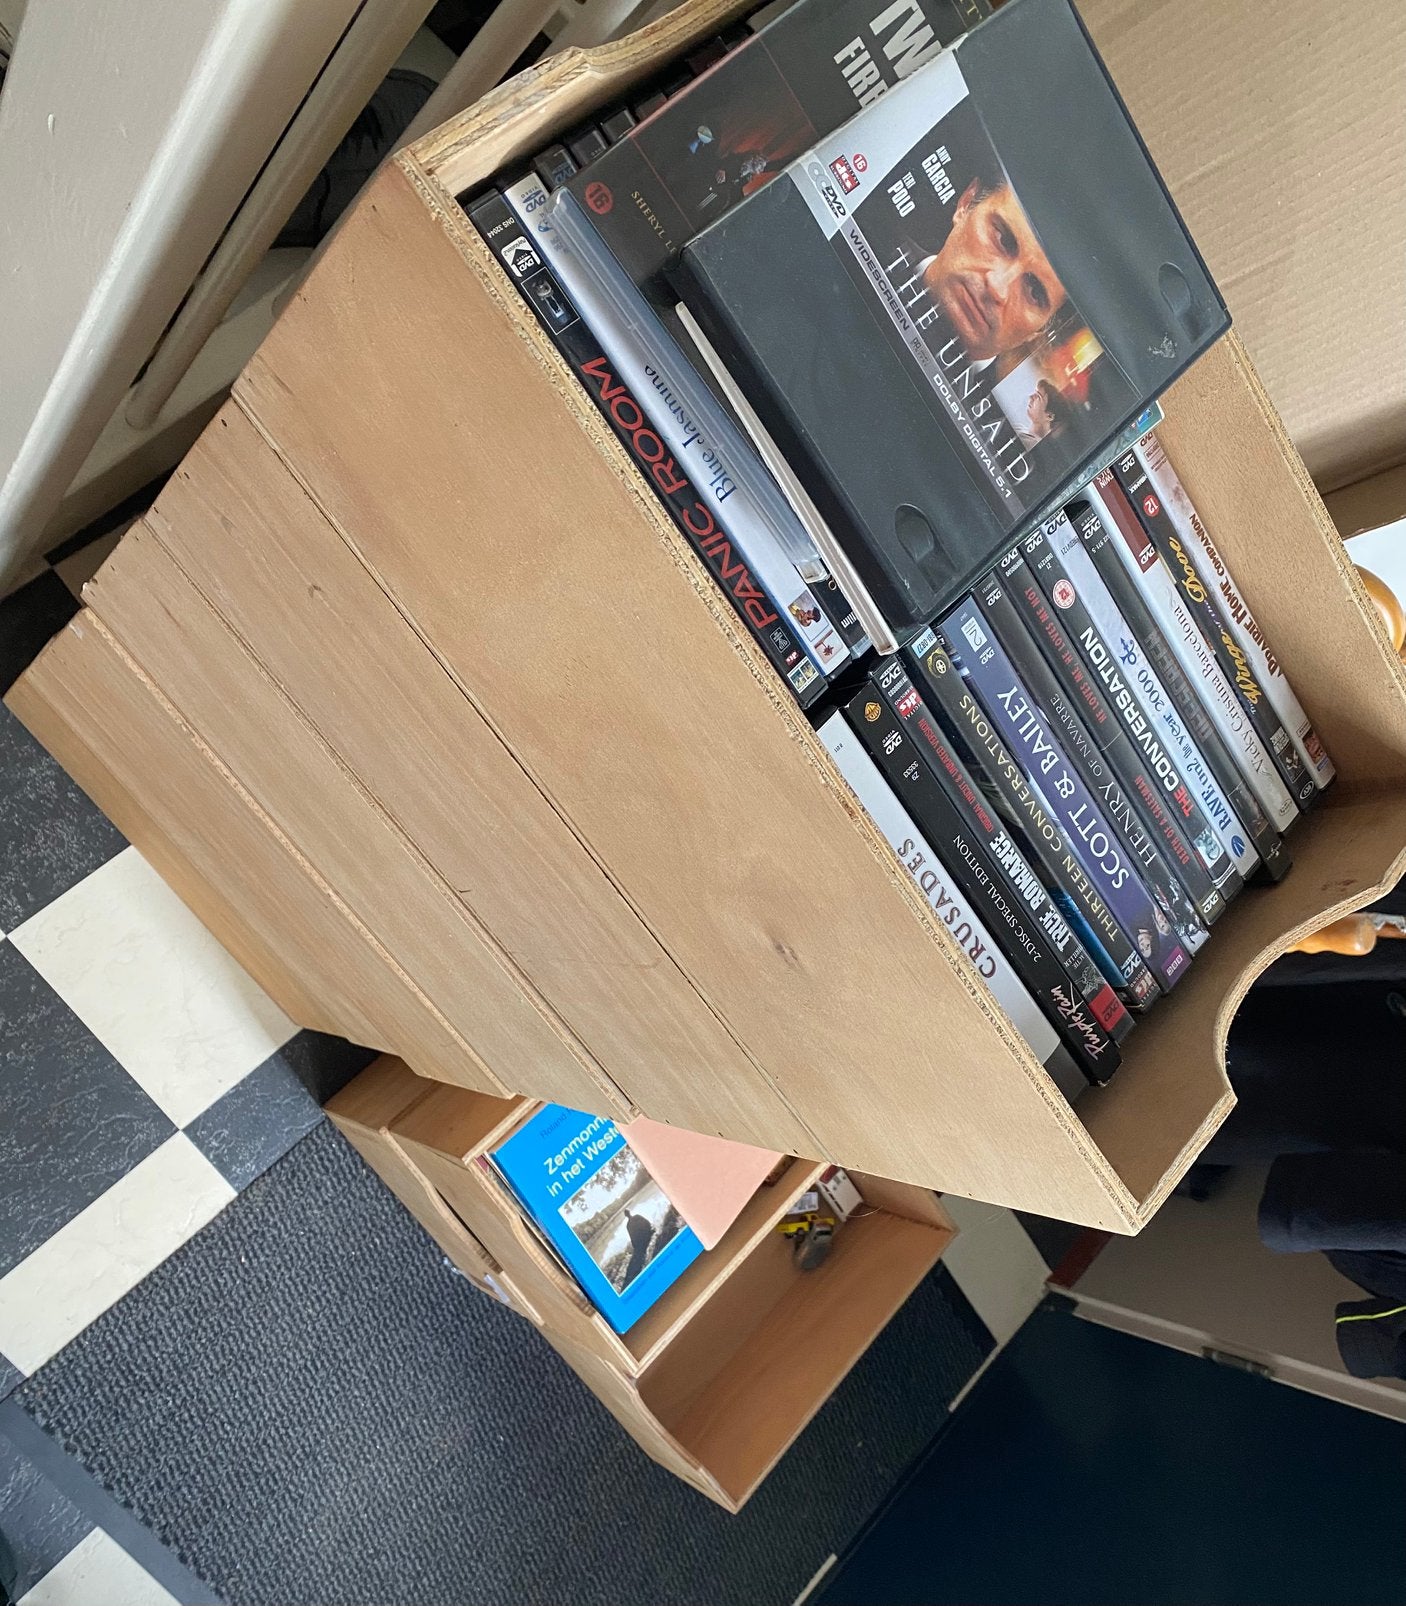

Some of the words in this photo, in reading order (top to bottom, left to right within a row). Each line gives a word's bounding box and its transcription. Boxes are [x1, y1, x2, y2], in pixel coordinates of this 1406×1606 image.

[854, 155, 866, 171] 16
[936, 146, 951, 166] ANDY
[836, 163, 852, 188] dts
[903, 172, 916, 189] TERI
[922, 154, 955, 204] GARCIA
[526, 194, 546, 212] DVD
[632, 190, 665, 238] SHERYL
[825, 186, 846, 216] DVD
[887, 180, 916, 217] POLO
[518, 256, 534, 272] DVD
[850, 228, 910, 331] WIDESCREEN
[884, 247, 940, 330] THE
[935, 336, 1031, 483] UNSAID
[644, 364, 706, 450] Jasmine
[580, 357, 688, 494] ROOM
[933, 374, 966, 422] DOLBY
[963, 419, 996, 476] DIGITAL
[995, 476, 1012, 498] 5.1
[702, 449, 738, 503] Blue
[1122, 456, 1136, 473] DVD
[1145, 498, 1158, 515] 12
[1047, 514, 1068, 535] DVD
[1084, 516, 1102, 540] DVD
[1001, 549, 1018, 568] DVD
[1026, 533, 1044, 553] DVD
[1140, 546, 1155, 564] DVD
[1189, 514, 1225, 578] COMPANION
[682, 502, 778, 629] PANIC
[1168, 536, 1208, 602] Dove
[988, 587, 1002, 606] DVD
[1024, 586, 1040, 607] NOT
[1036, 606, 1048, 622] ME
[1220, 582, 1248, 624] HOME
[1045, 622, 1066, 650] LOVES
[1174, 606, 1214, 679] Barcelona
[980, 647, 994, 664] DVD
[1062, 652, 1073, 665] HE
[1221, 632, 1262, 704] Wings
[882, 666, 902, 688] DVD
[1138, 669, 1165, 712] 2000
[900, 692, 917, 712] dts
[1080, 684, 1098, 711] LOVES
[1080, 626, 1180, 792] CONVERSATION
[1212, 674, 1243, 732] Cristina
[997, 686, 1060, 776] BAILEY
[1050, 693, 1088, 758] NAVARRE
[1096, 711, 1106, 723] HE
[1162, 713, 1185, 746] year
[886, 734, 902, 755] DVD
[1241, 730, 1264, 774] Vicky
[959, 694, 1062, 852] CONVERSATIONS
[1054, 770, 1076, 799] &
[1087, 760, 1103, 776] OF
[959, 782, 976, 804] UNCUT
[1134, 776, 1161, 818] SALESMAN
[1173, 786, 1194, 818] THE
[1201, 786, 1232, 832] RAVE
[1099, 782, 1156, 867] HENRY
[1160, 817, 1167, 826] A
[1164, 828, 1174, 837] OF
[952, 834, 990, 886] EDITION
[1068, 803, 1130, 888] SCOTT
[1172, 838, 1190, 864] DEATH
[988, 830, 1046, 911] ROMANCE
[898, 838, 997, 979] CRUSADES
[987, 884, 1018, 928] SPECIAL
[1062, 854, 1118, 942] THIRTEEN
[1204, 890, 1219, 913] DVD
[1014, 924, 1042, 963] 2-DISC
[1038, 904, 1072, 952] TRUE
[1124, 954, 1142, 979] DVD
[1050, 981, 1084, 1020] Rain
[1103, 998, 1120, 1022] DVD
[543, 1115, 608, 1175] Zenmonn
[546, 1178, 563, 1198] in
[560, 1160, 586, 1184] het
